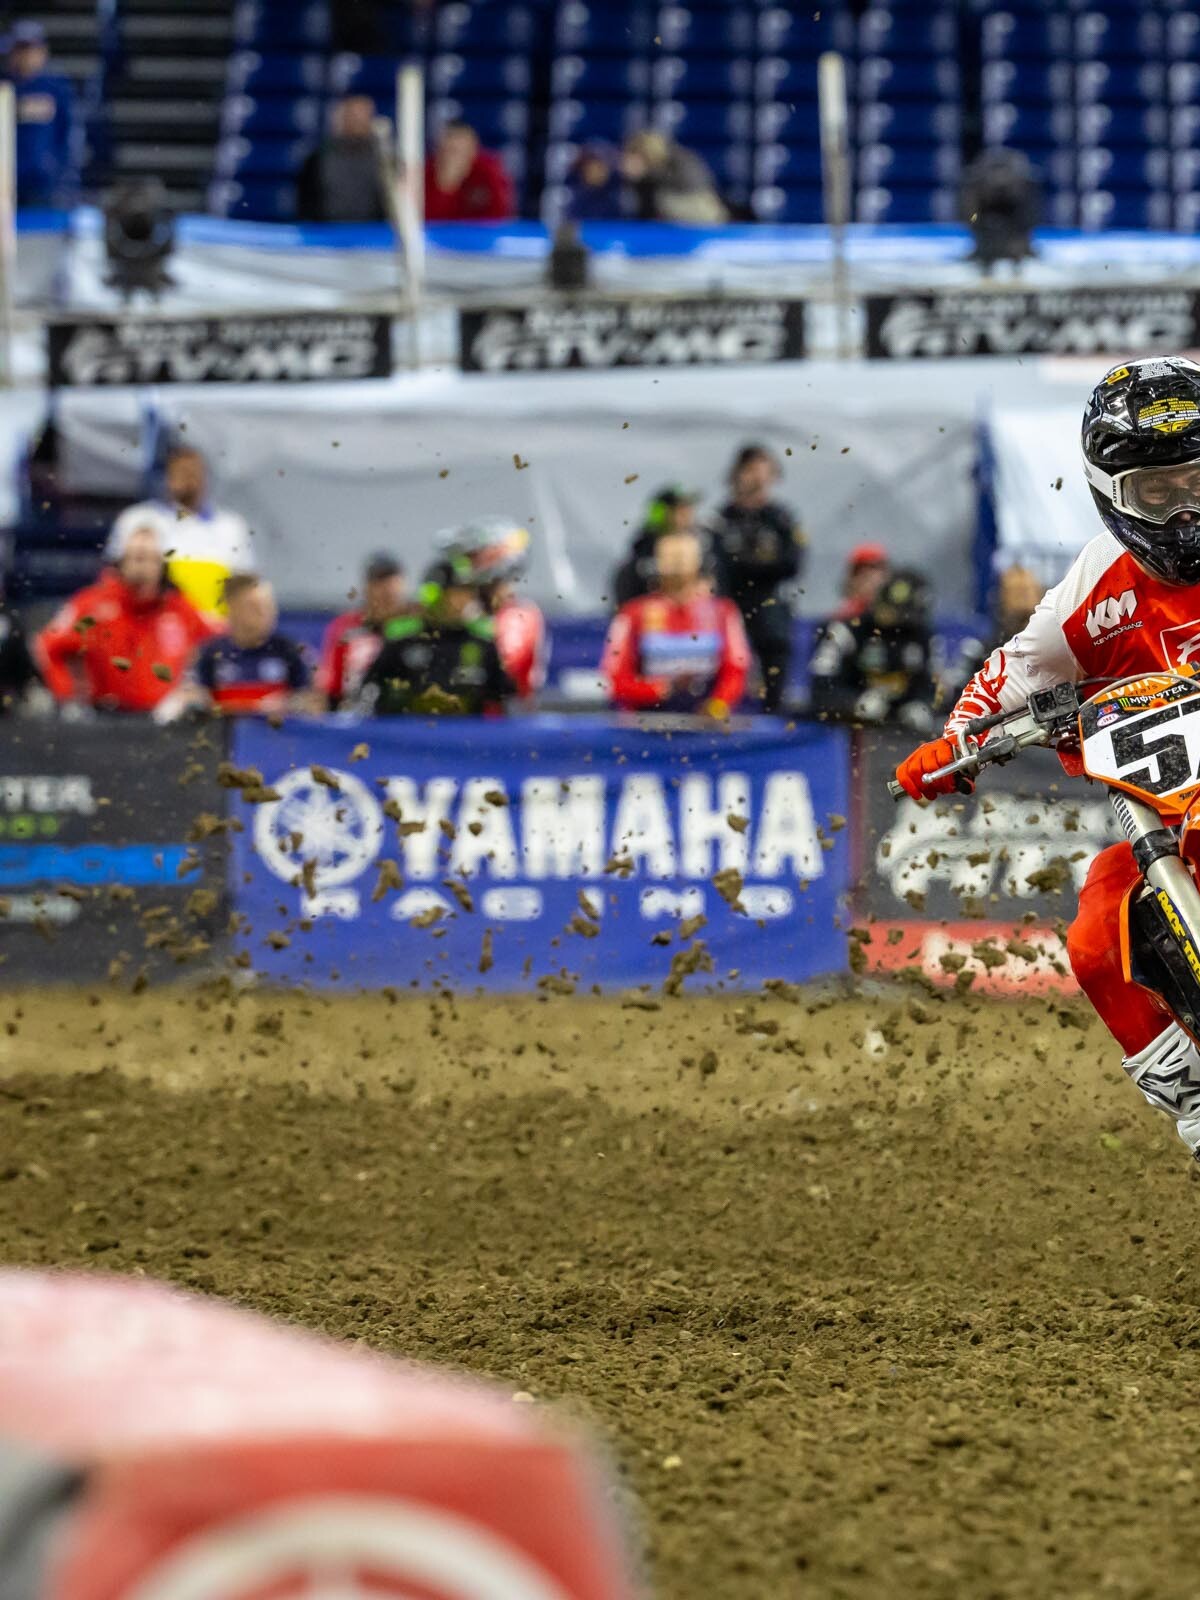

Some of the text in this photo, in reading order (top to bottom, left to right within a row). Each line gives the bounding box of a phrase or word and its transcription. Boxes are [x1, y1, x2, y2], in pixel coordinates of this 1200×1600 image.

[1129, 684, 1188, 705] MONSTER
[382, 772, 824, 880] YAMAHA
[1157, 889, 1185, 940] RACE
